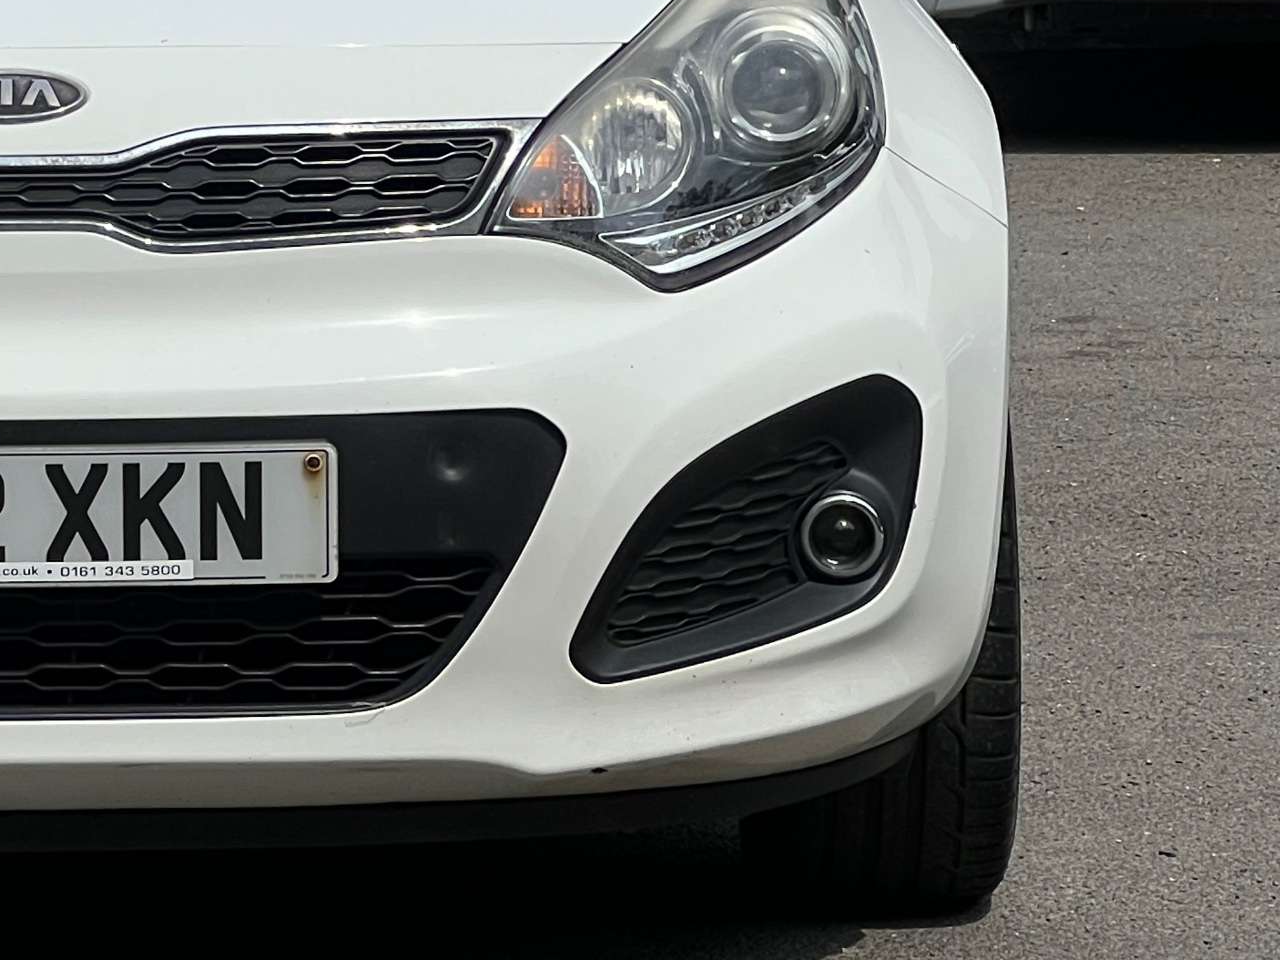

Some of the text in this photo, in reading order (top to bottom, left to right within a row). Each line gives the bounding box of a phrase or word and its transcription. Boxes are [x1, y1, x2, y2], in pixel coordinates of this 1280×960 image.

[44, 461, 263, 563] XKN
[60, 566, 96, 577] 0161
[104, 566, 135, 577] 343
[141, 565, 181, 576] 5800
